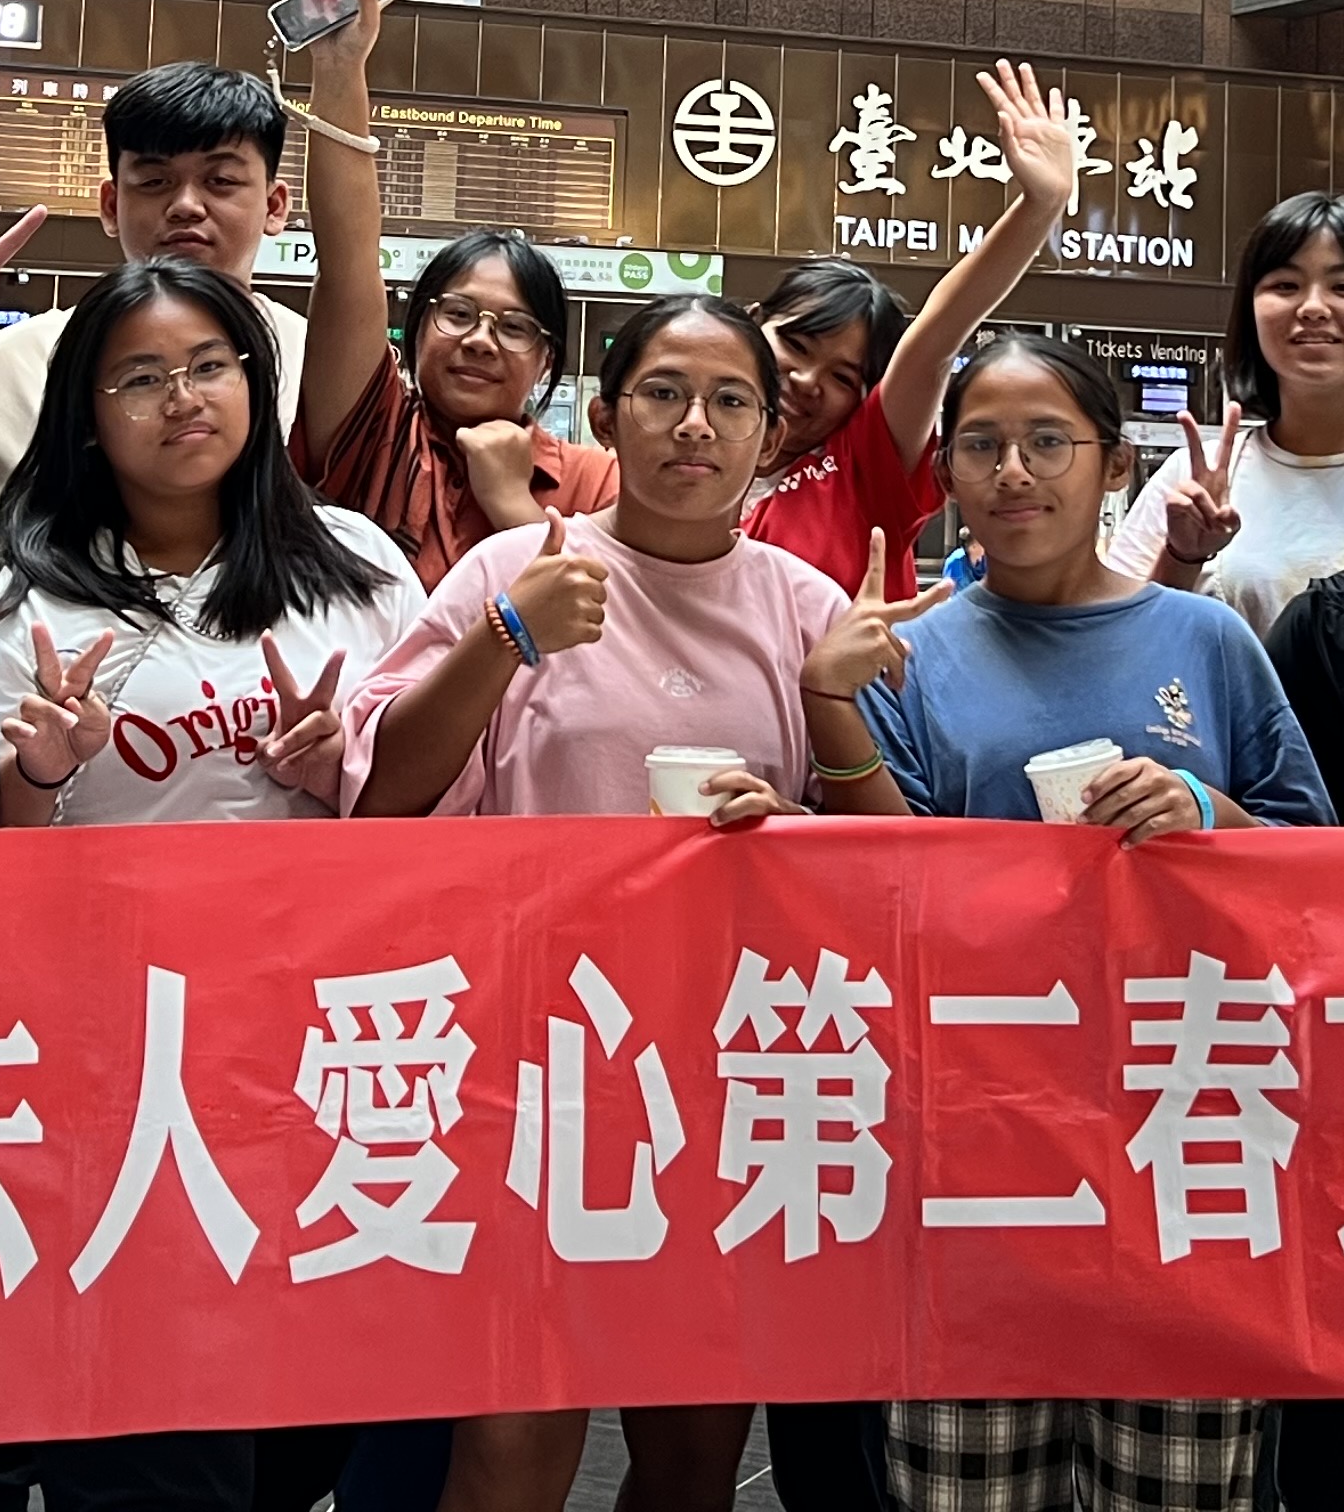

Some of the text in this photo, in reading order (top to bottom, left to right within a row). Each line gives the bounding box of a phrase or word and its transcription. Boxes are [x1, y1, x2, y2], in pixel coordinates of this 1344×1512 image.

[380, 105, 455, 124] Eastbound
[458, 110, 526, 128] Departure
[529, 116, 562, 131] Time
[834, 215, 937, 251] TAIPEI
[1061, 229, 1193, 267] STATION
[1086, 339, 1142, 359] Tickets
[1150, 343, 1207, 364] Vending
